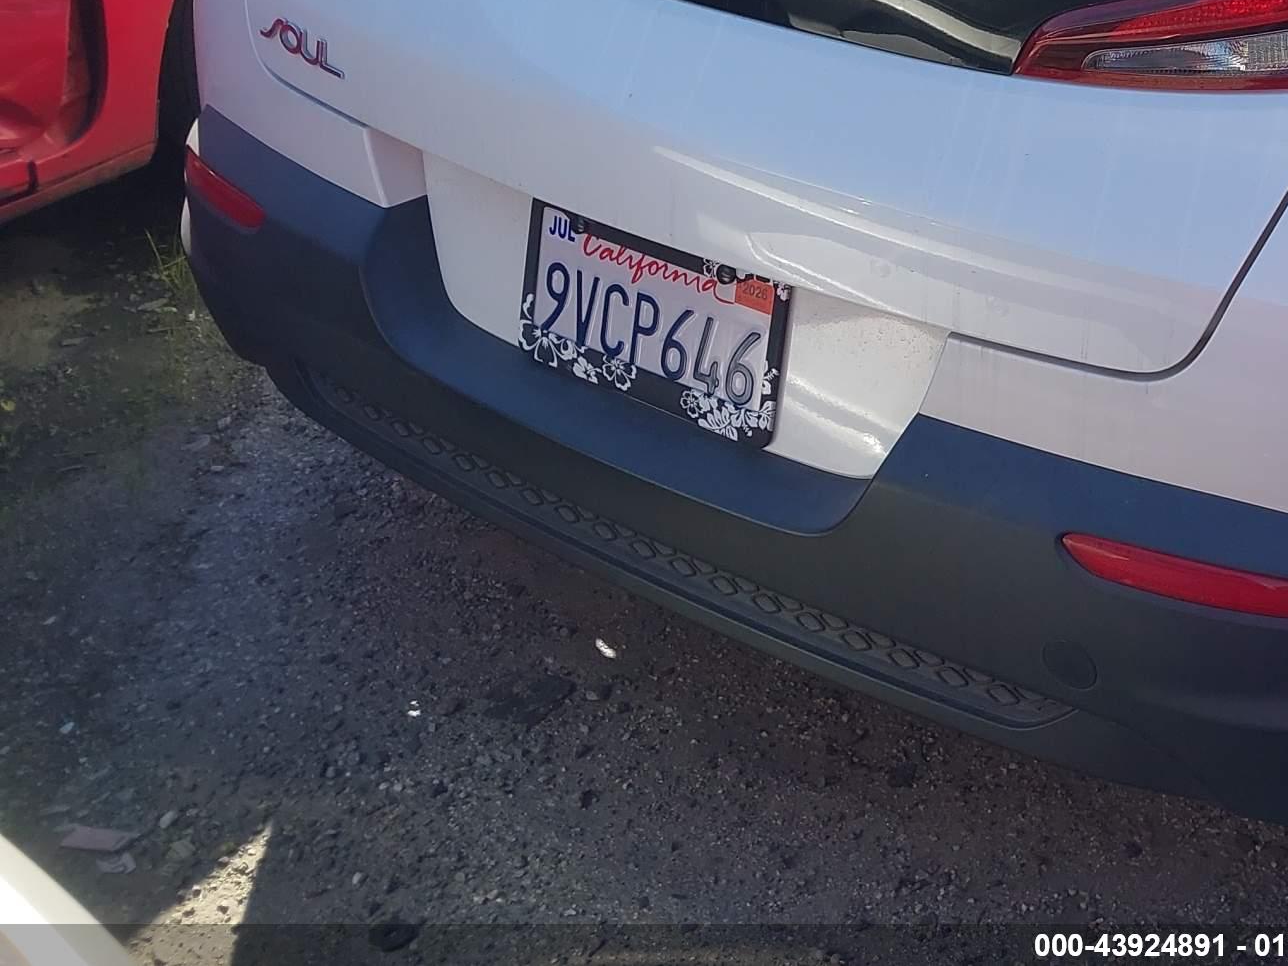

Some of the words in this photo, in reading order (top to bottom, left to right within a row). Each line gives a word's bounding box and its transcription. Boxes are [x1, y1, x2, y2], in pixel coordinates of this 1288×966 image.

[259, 17, 345, 80] SOUL
[549, 215, 576, 243] JUL
[583, 232, 735, 305] California
[742, 281, 768, 301] 2026
[546, 261, 762, 407] 9VCP646
